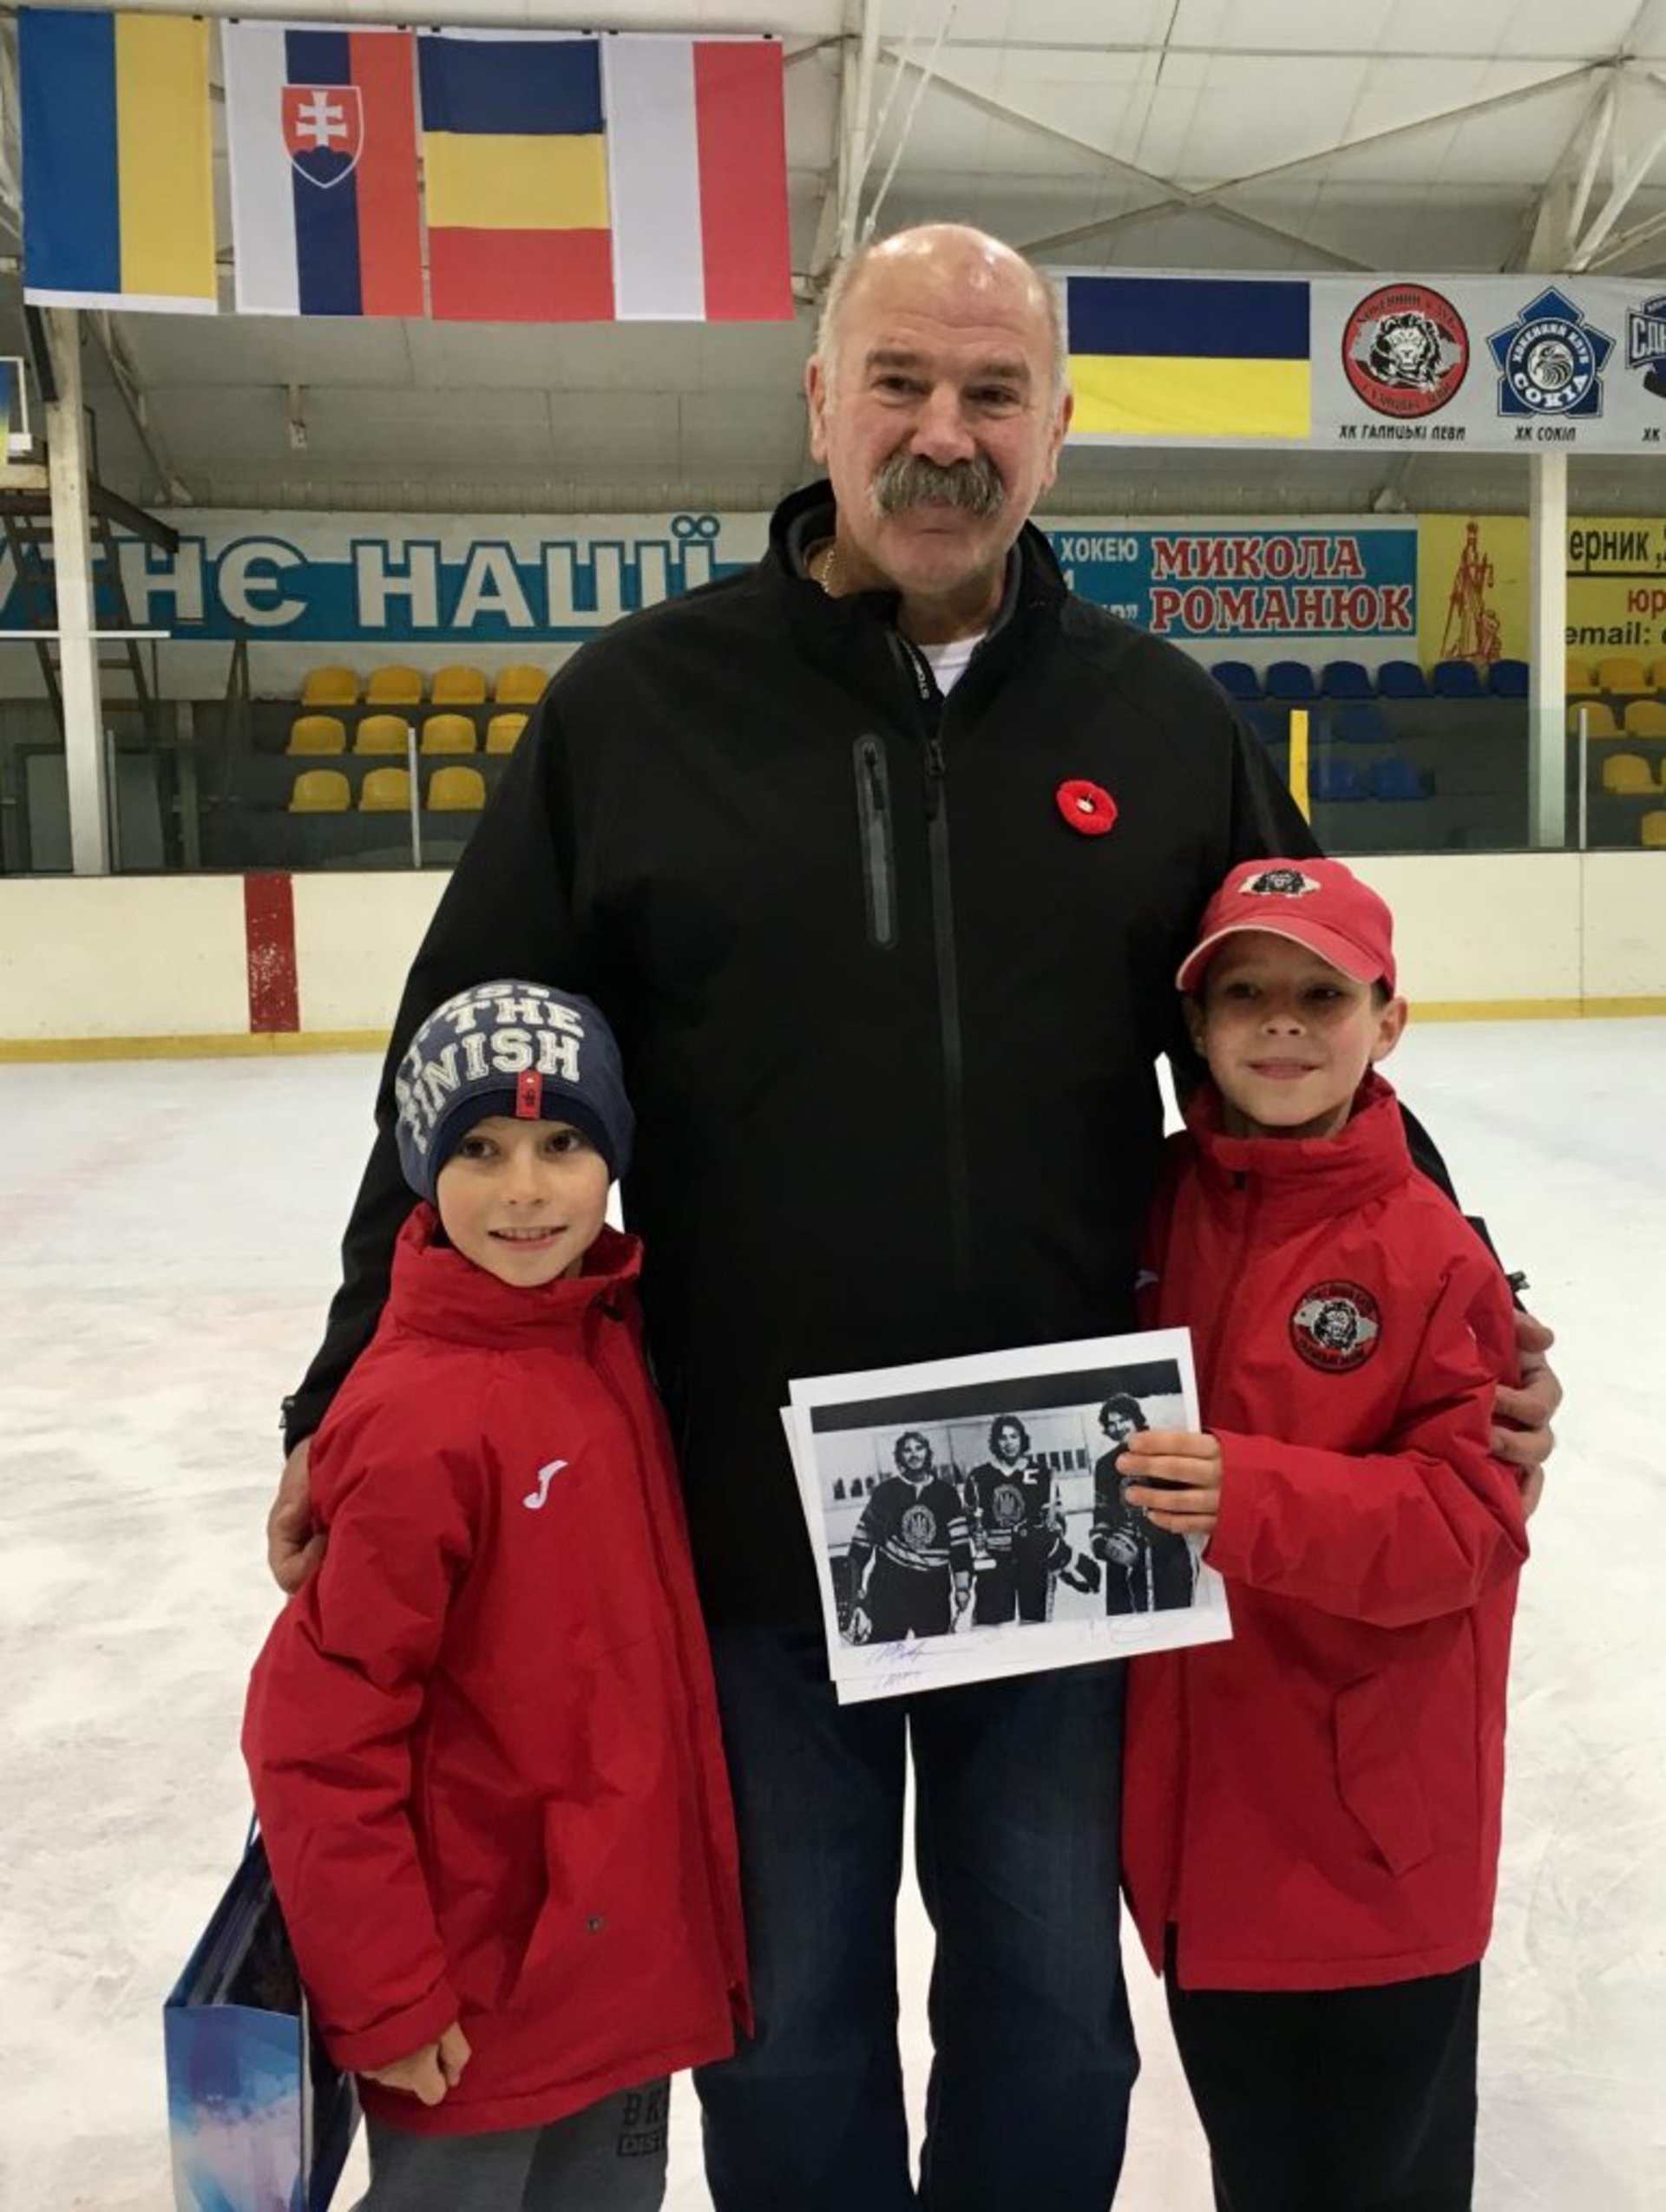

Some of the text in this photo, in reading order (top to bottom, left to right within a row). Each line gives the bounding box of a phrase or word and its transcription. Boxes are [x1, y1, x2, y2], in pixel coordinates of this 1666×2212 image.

[1339, 425, 1357, 440] ХК
[1514, 426, 1534, 441] ХК
[1642, 427, 1660, 442] ХК
[1060, 536, 1138, 562] ХОКЕЮ
[1151, 537, 1367, 579] МИКОЛА
[1149, 586, 1413, 633] РОМАНЮК
[1565, 621, 1650, 645] email:
[446, 998, 585, 1038] THE
